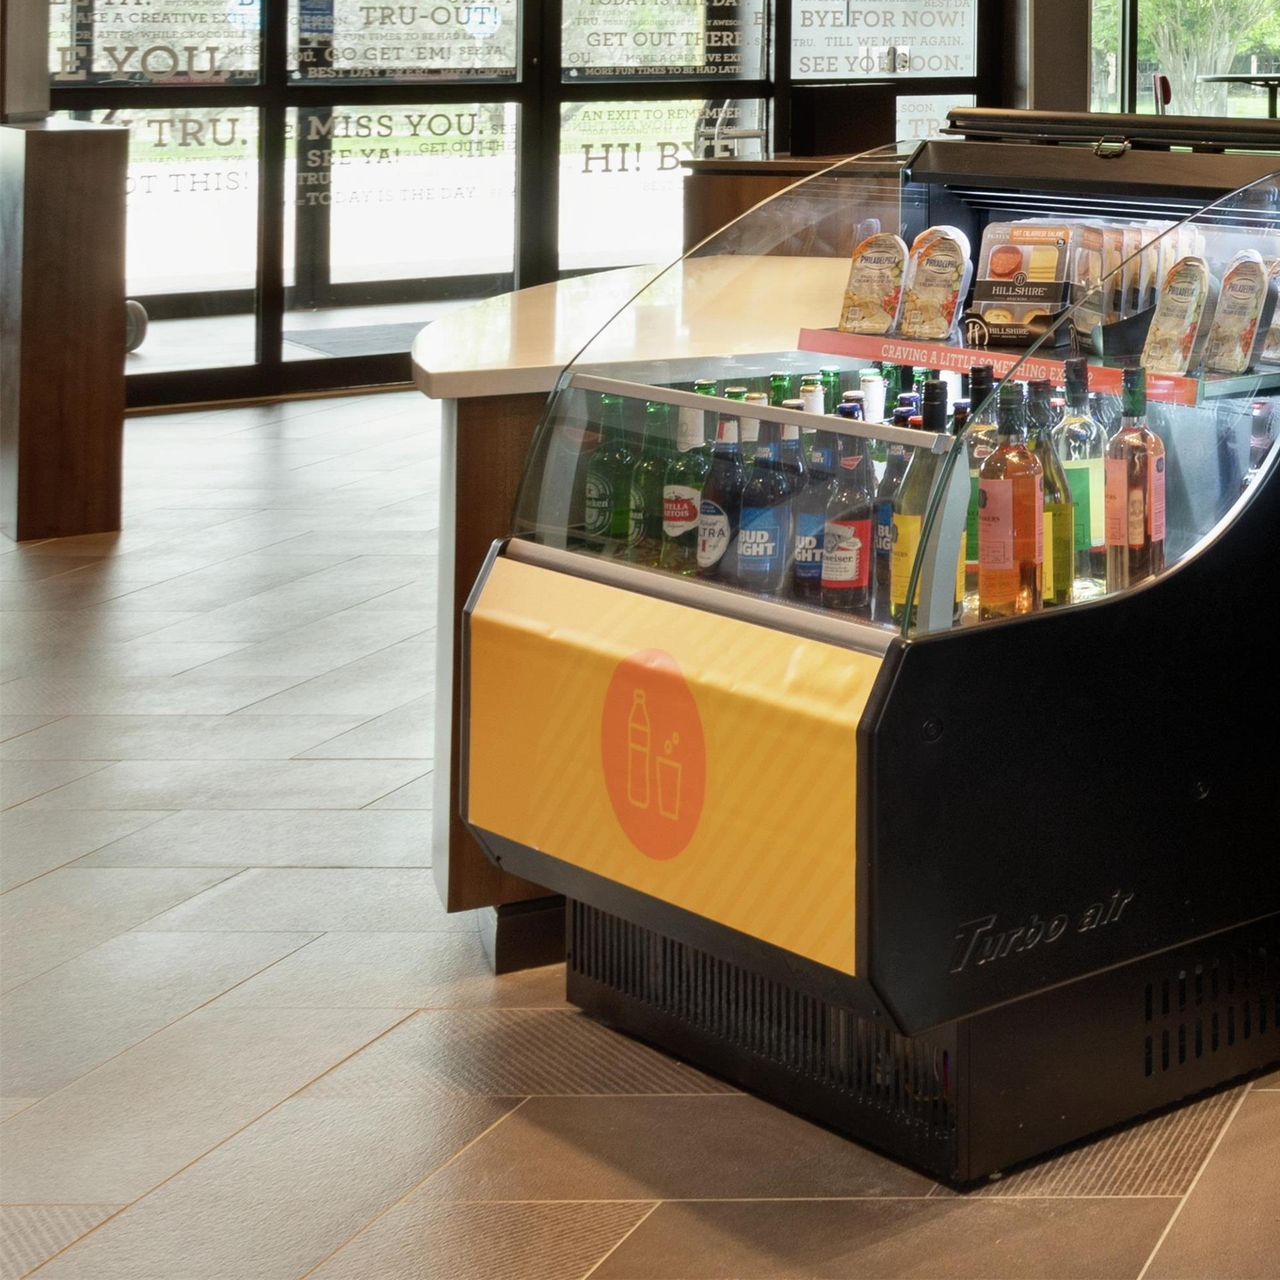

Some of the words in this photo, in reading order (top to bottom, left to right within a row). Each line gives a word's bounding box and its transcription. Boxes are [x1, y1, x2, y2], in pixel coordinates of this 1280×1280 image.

[61, 12, 109, 24] MAKE
[113, 12, 126, 24] A
[129, 12, 209, 24] CREATIVE
[359, 6, 499, 26] TRU-OUT!
[800, 11, 844, 27] BYE
[850, 10, 896, 27] FOR
[902, 10, 965, 27] NOW!
[369, 32, 403, 41] TIMES
[586, 32, 627, 48] GET
[633, 32, 676, 48] OUT
[681, 31, 750, 48] THERE.
[793, 38, 816, 47] TRU.
[825, 37, 853, 47] TILL
[857, 37, 878, 47] WE
[882, 36, 916, 47] MEET
[919, 36, 964, 47] AGAIN.
[103, 45, 231, 80] YOU.
[324, 47, 357, 61] GO
[363, 47, 404, 61] GET
[307, 67, 345, 78] BEST
[349, 67, 384, 78] DAY
[585, 66, 614, 76] MORE
[615, 66, 636, 75] FUN
[638, 66, 668, 75] TIMES
[669, 66, 682, 75] TO
[683, 66, 696, 75] BE
[697, 65, 718, 74] HAD
[799, 56, 838, 73] SEE
[581, 108, 602, 121] AN
[607, 108, 641, 120] EXIT
[644, 108, 665, 120] TO
[667, 107, 742, 119] REMEMBER
[901, 103, 936, 113] SOON.
[147, 118, 249, 149] TRU.
[307, 115, 395, 140] MISS
[406, 113, 484, 138] YOU.
[307, 148, 353, 167] SEE
[581, 142, 642, 173] HI!
[169, 171, 249, 194] THIS!
[992, 286, 1045, 296] HILLSHIRE
[989, 327, 1029, 335] HILLSHIRE
[881, 344, 928, 363] CRAVING
[930, 352, 938, 363] A
[940, 353, 974, 368] LITTLE
[950, 914, 1069, 973] Turbo
[1077, 888, 1135, 933] air
